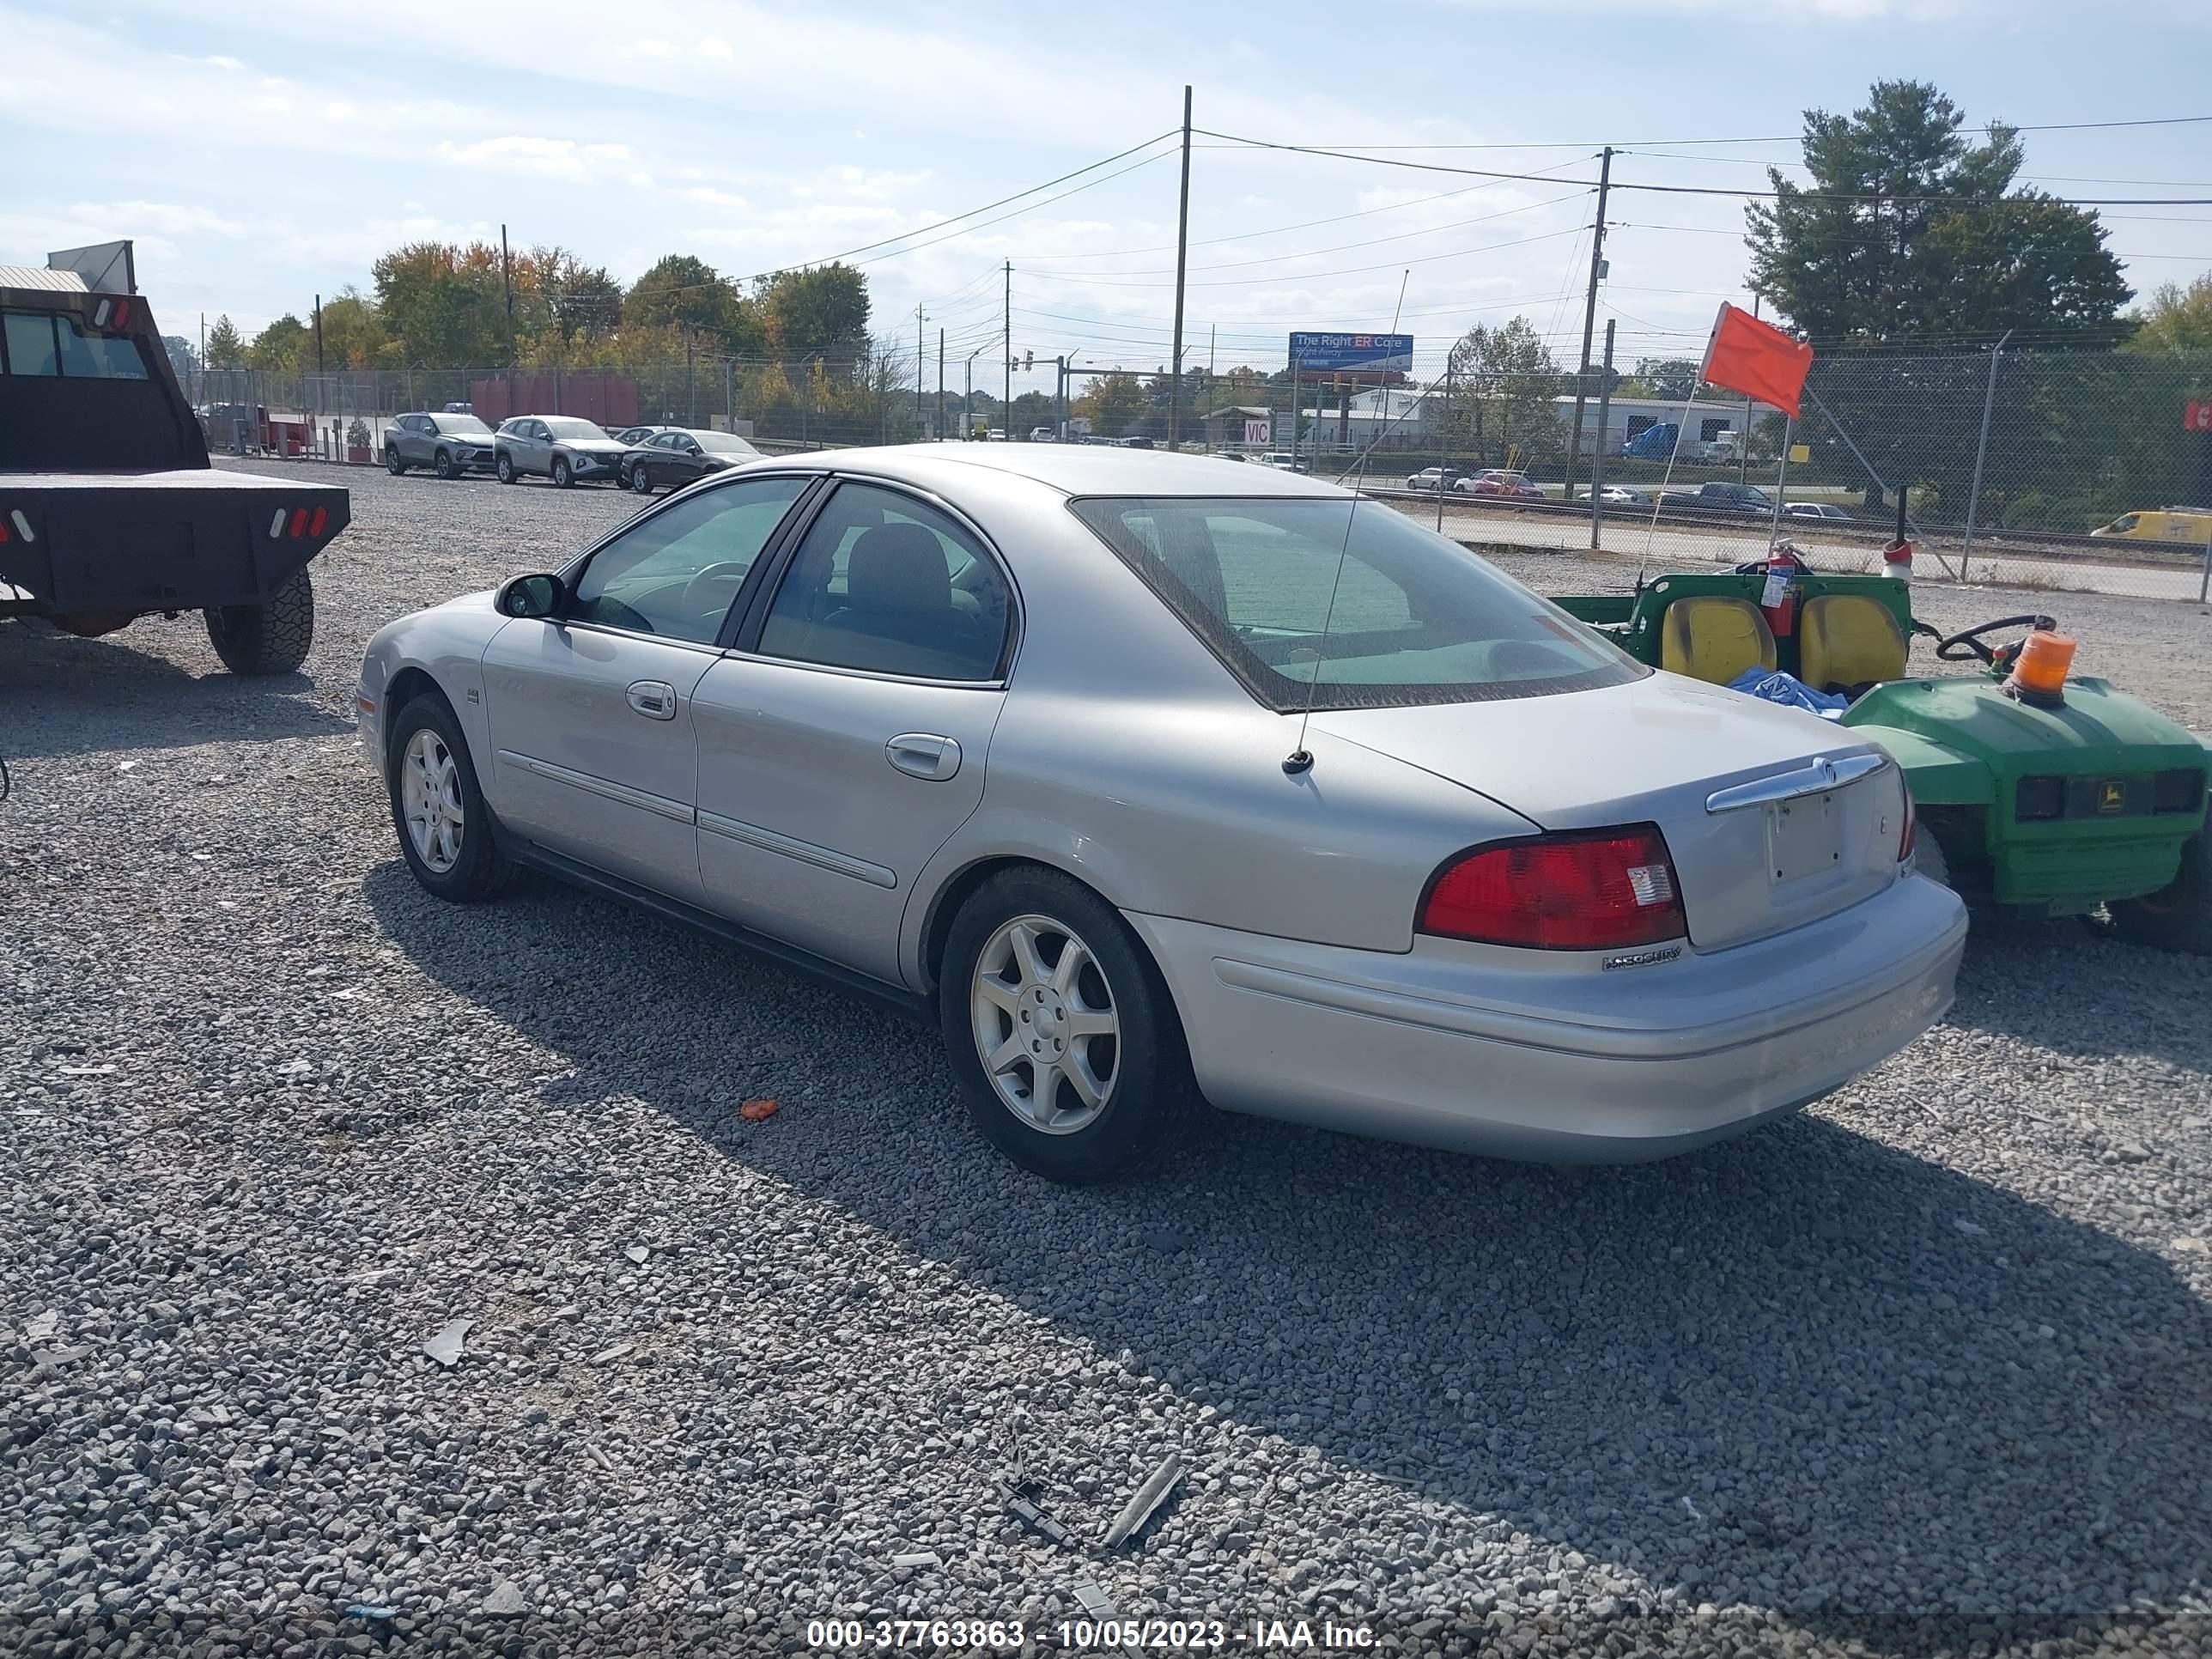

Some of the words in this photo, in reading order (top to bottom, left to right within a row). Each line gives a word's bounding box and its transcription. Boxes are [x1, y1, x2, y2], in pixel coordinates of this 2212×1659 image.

[1297, 335, 1318, 345] The
[1322, 336, 1352, 348] Right
[1355, 336, 1371, 347] ER
[1375, 337, 1401, 348] Care
[1248, 423, 1267, 442] VIC
[1602, 945, 1681, 971] MERCURY
